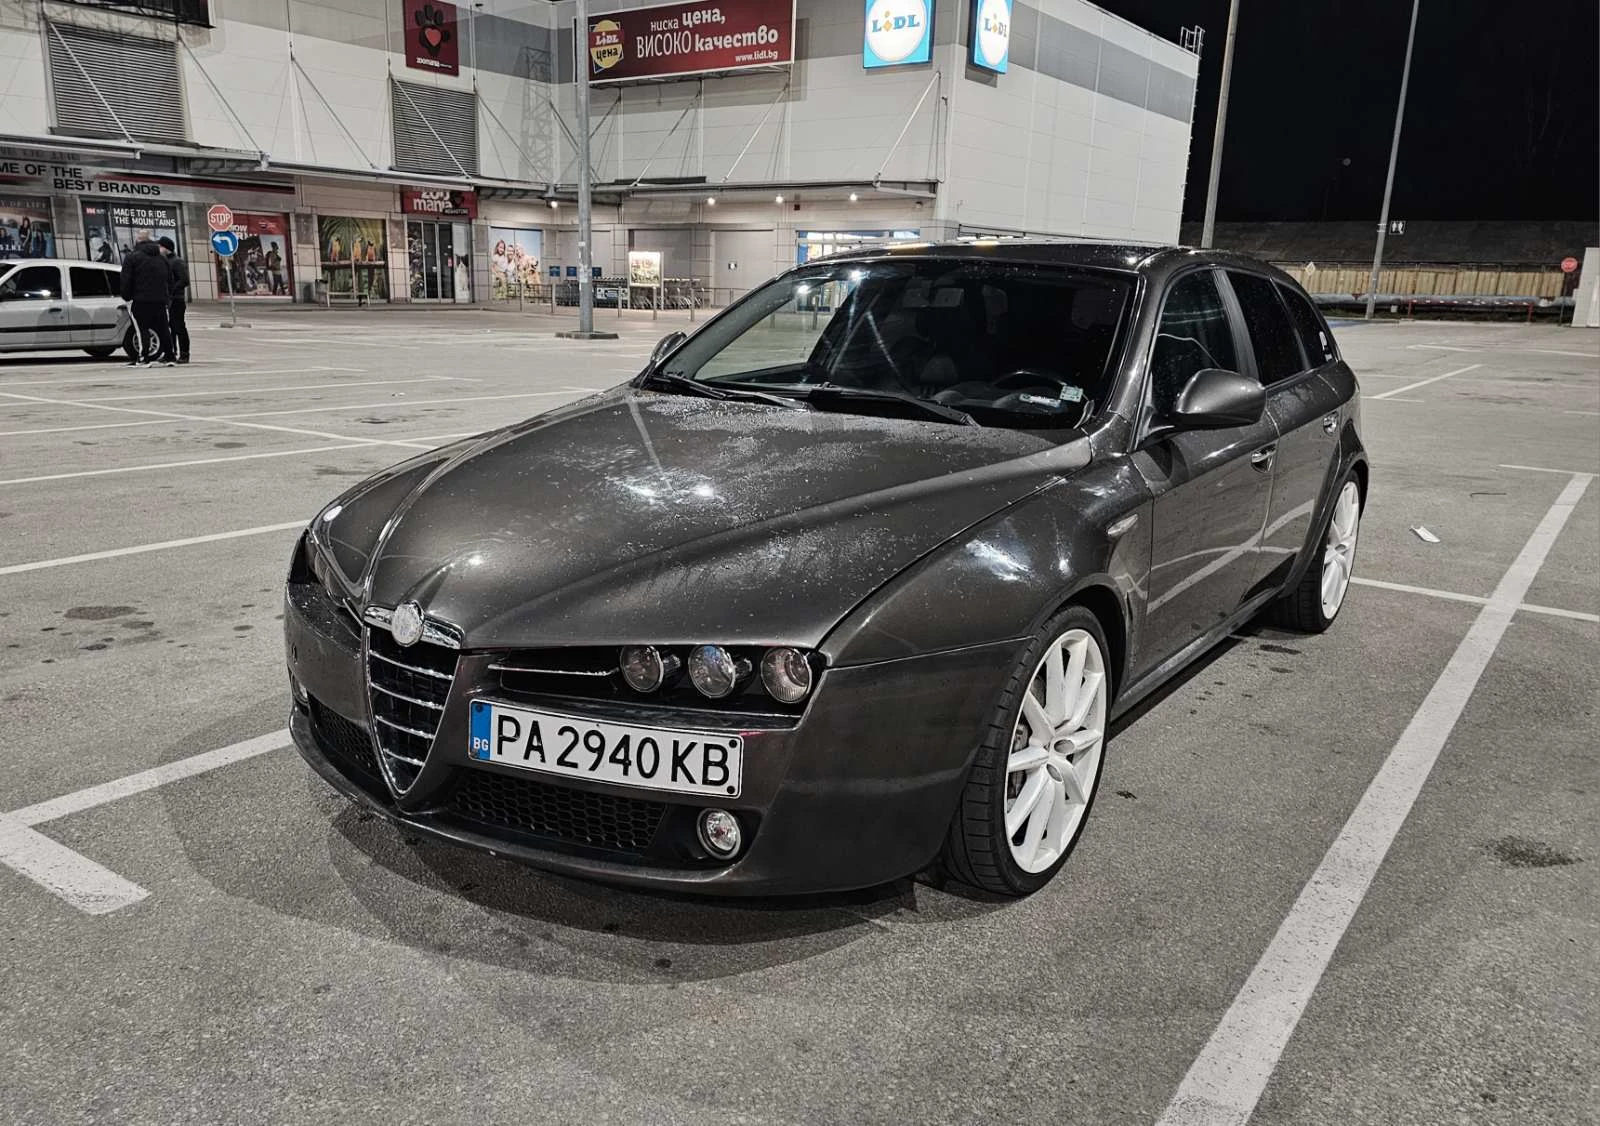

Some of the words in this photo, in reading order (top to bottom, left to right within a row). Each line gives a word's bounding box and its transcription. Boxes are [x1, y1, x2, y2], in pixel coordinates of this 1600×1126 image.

[650, 18, 679, 32] ниска
[682, 7, 725, 29] цена,
[636, 30, 691, 59] ВИСОКО
[695, 24, 779, 52] качество
[595, 46, 619, 60] цена
[735, 50, 779, 63] www.lidl.bg
[24, 163, 47, 176] OF
[51, 165, 83, 179] THE
[54, 178, 94, 192] BEST
[99, 181, 161, 196] BRANDS
[137, 209, 147, 217] TO
[210, 213, 231, 226] STOP
[114, 216, 131, 225] THE
[131, 217, 176, 227] MOUNTAINS
[473, 736, 489, 751] BG
[496, 714, 547, 764] PA
[556, 725, 660, 779] 2940
[670, 739, 730, 787] KB
